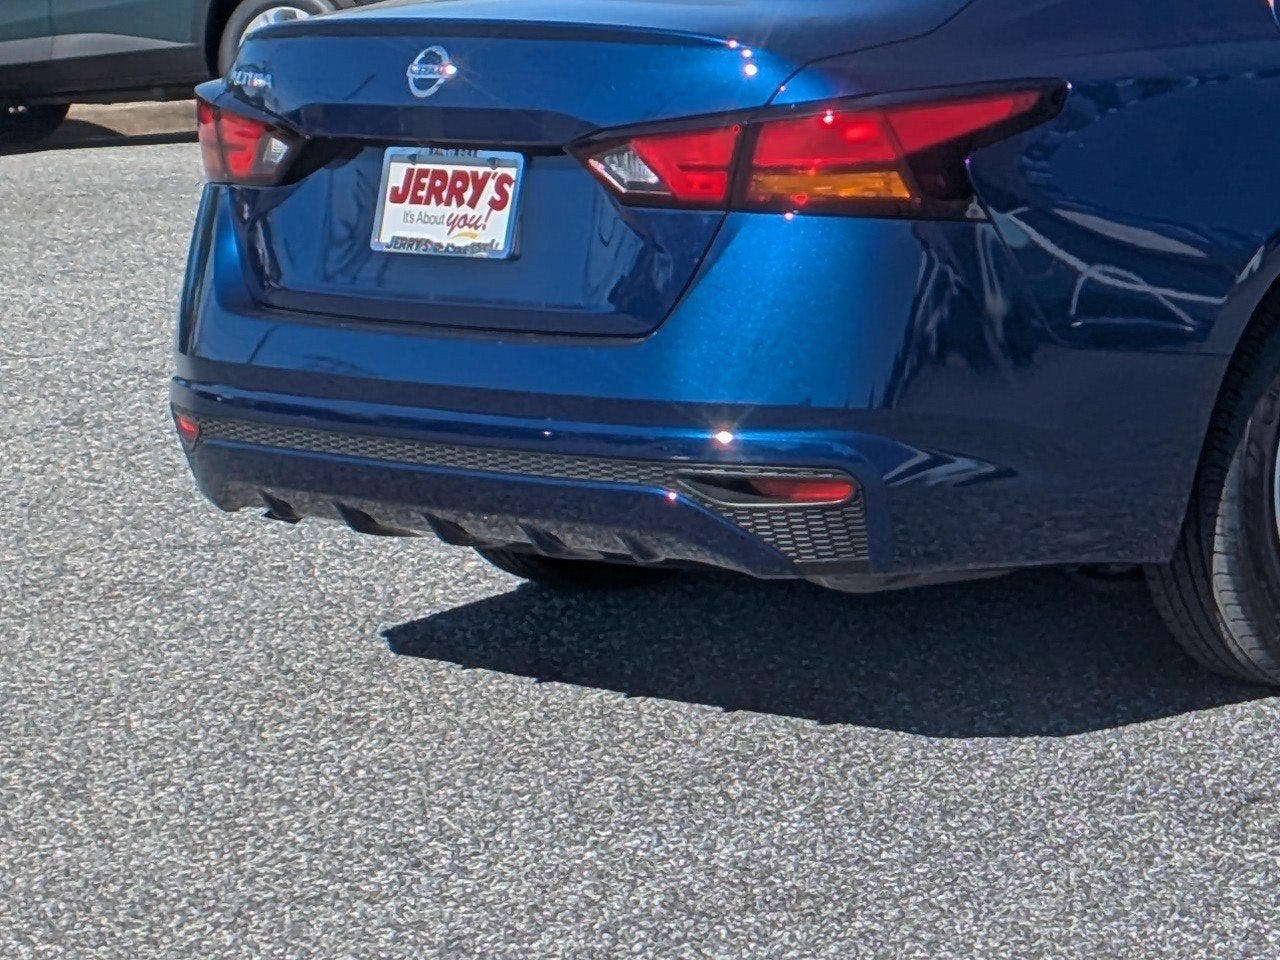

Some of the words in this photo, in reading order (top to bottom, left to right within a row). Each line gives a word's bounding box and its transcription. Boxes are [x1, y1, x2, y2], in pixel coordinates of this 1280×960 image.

[389, 167, 516, 212] JERRY'S
[403, 211, 415, 224] It's
[416, 212, 445, 225] About
[446, 207, 493, 236] you!
